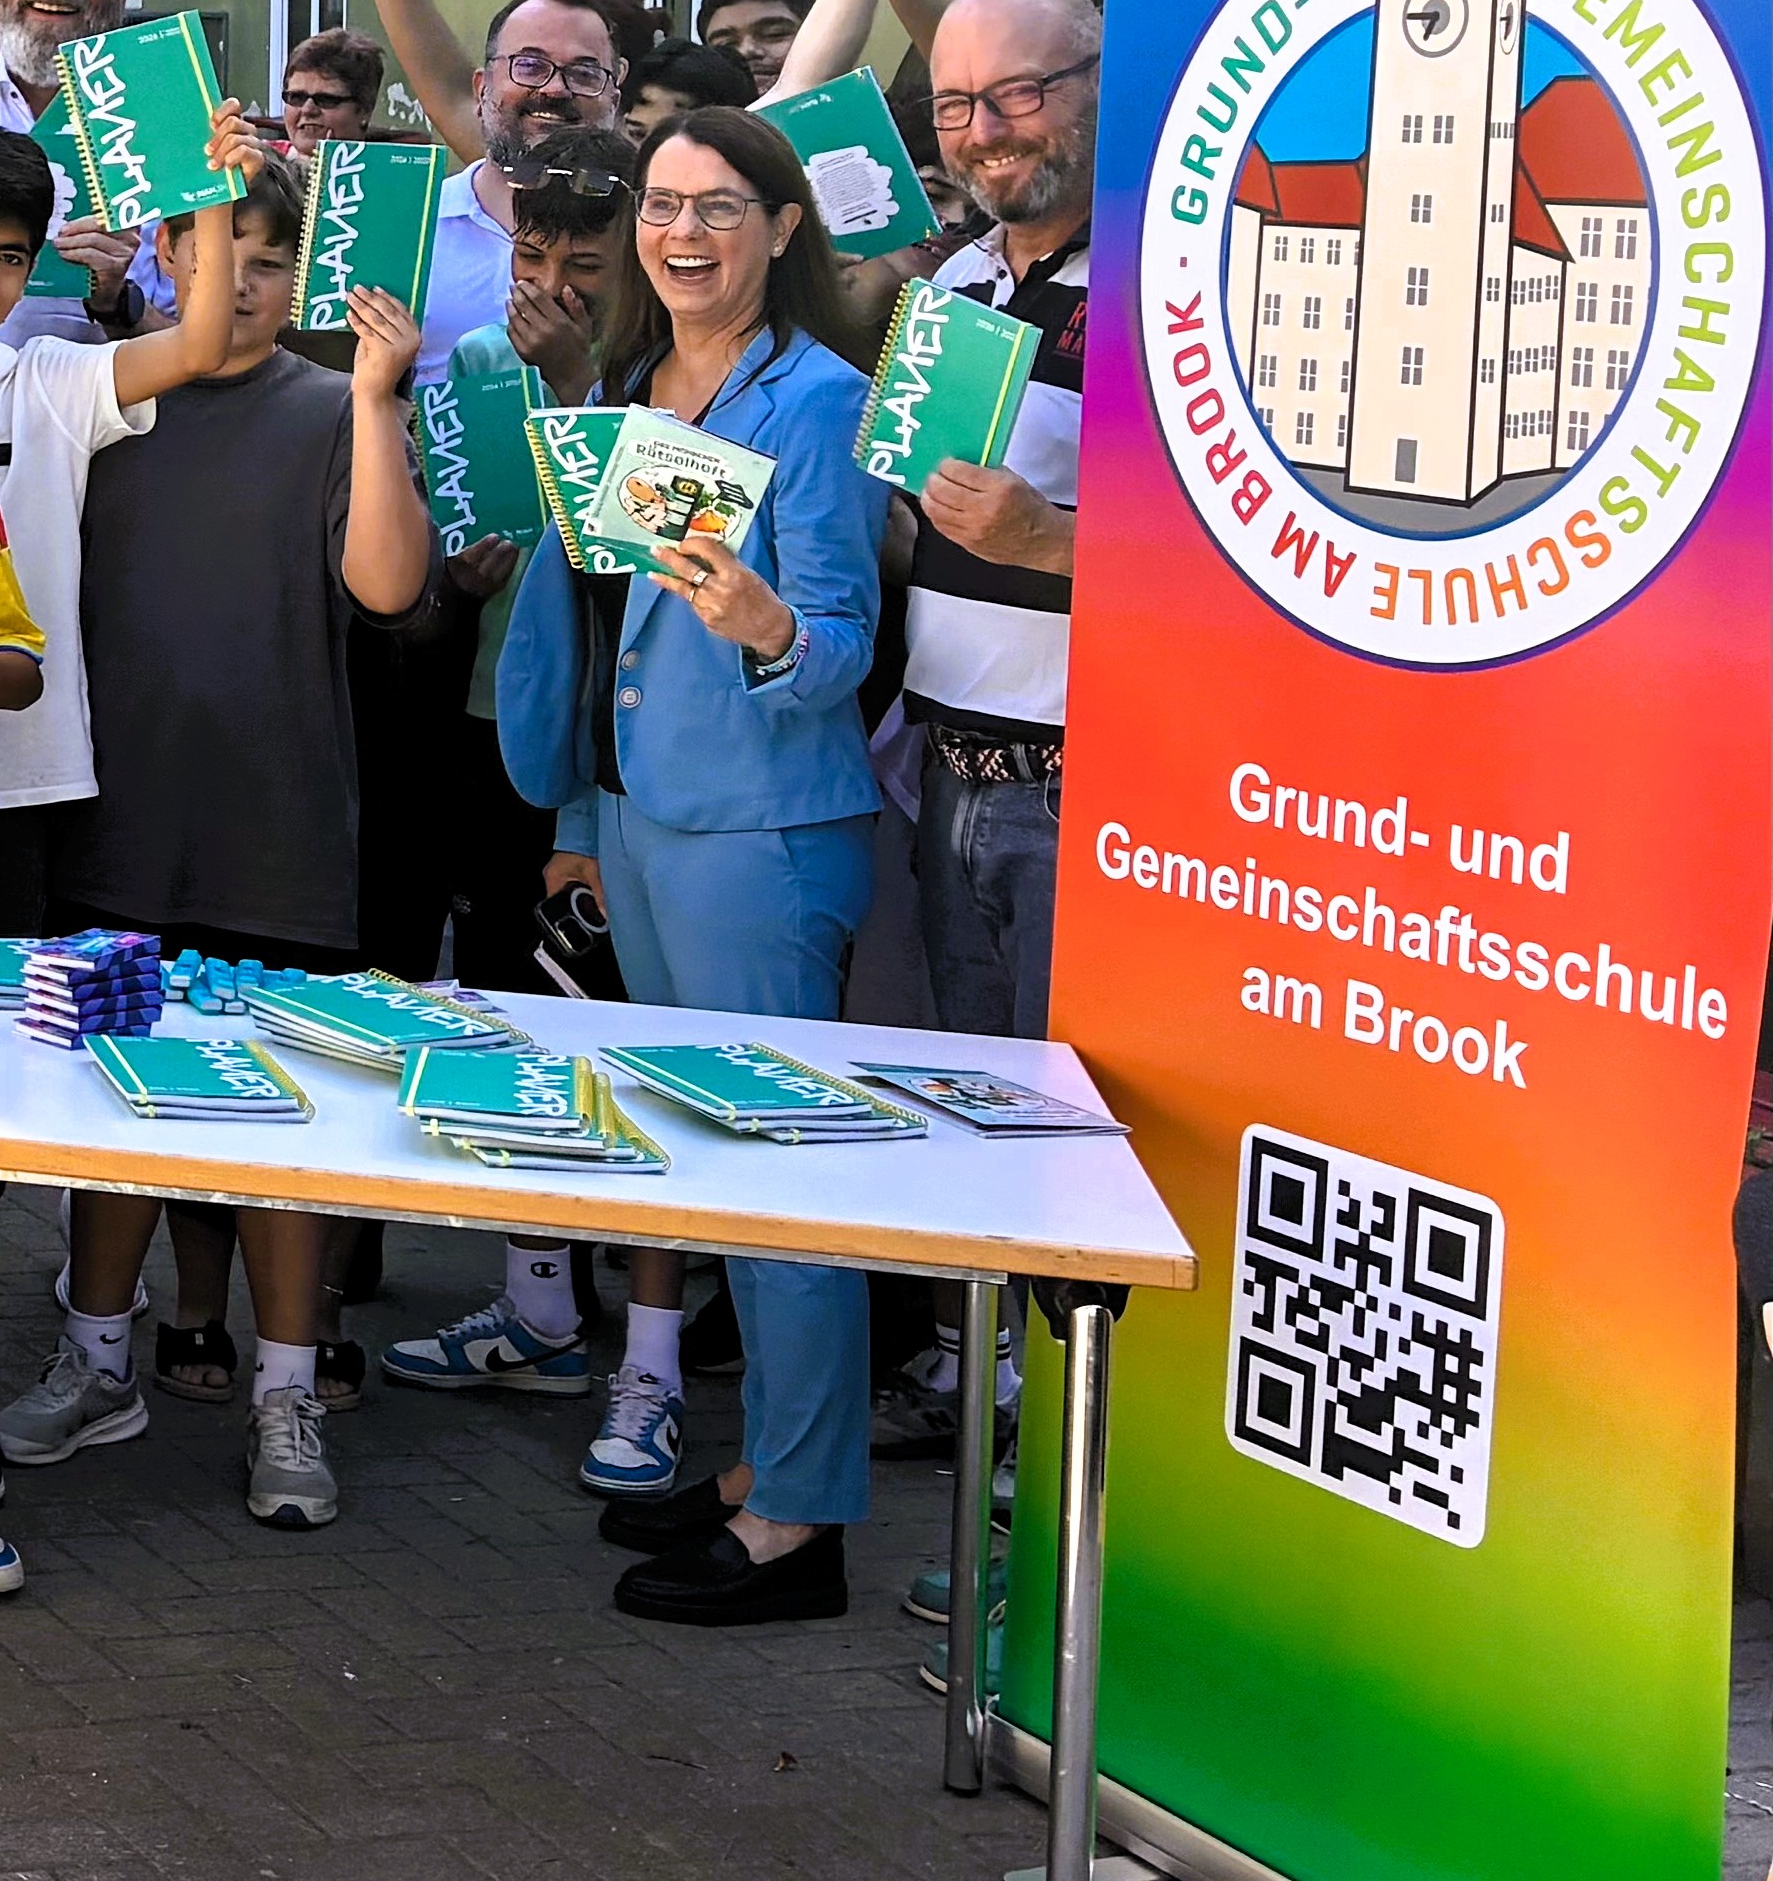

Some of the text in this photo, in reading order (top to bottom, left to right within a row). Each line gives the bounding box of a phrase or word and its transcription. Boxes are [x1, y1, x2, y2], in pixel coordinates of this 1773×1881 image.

[1167, 289, 1280, 523] BROOK
[543, 414, 637, 574] PNER
[1270, 510, 1357, 597] AM
[1229, 762, 1570, 894] Grund- und
[1095, 822, 1729, 1040] Gemeinschaftsschule
[1240, 965, 1530, 1090] am Brook
